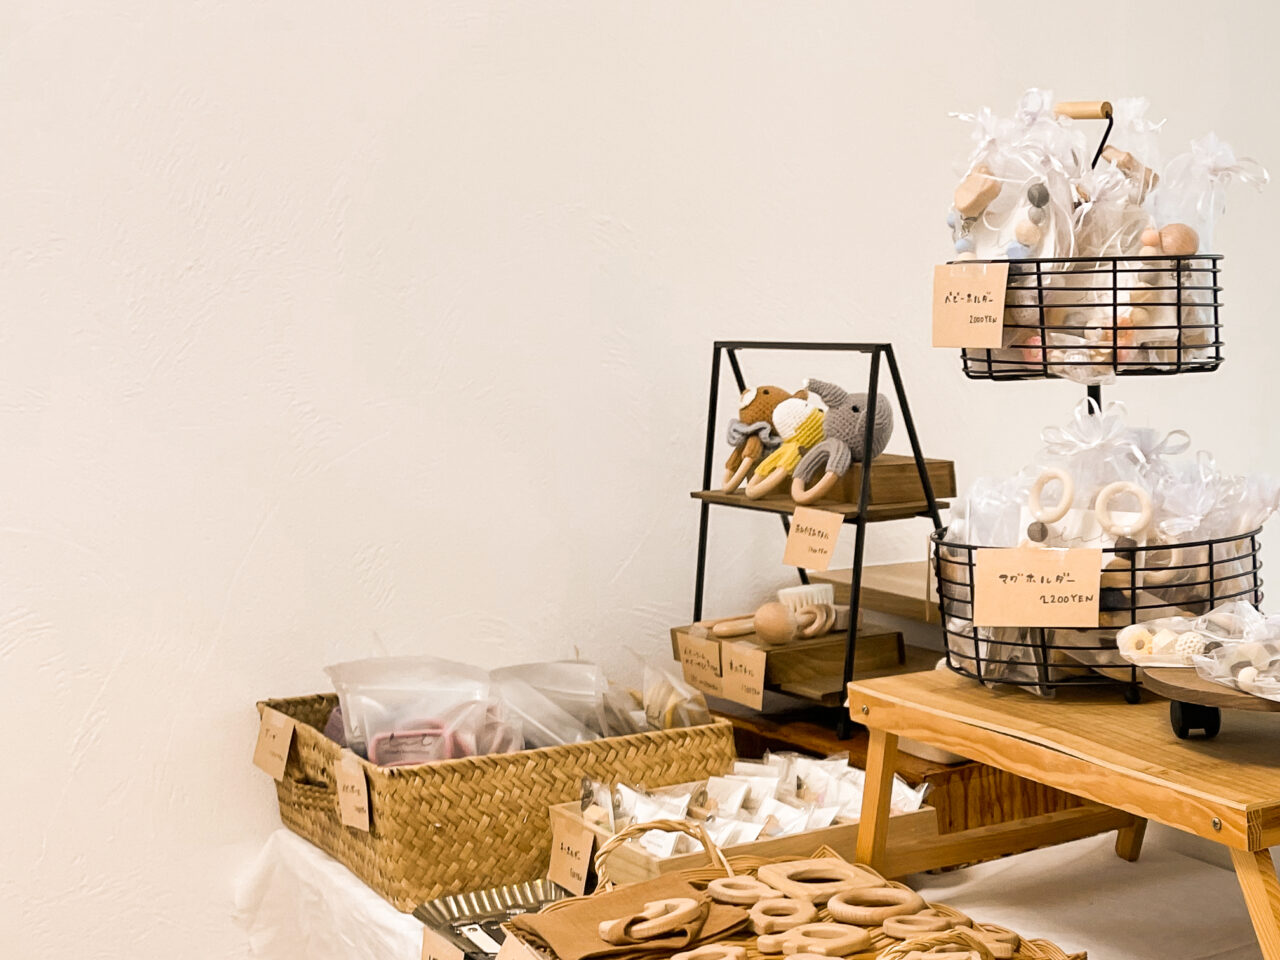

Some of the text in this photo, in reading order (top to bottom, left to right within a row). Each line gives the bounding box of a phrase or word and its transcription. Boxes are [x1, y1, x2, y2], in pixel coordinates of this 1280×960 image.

[998, 572, 1076, 585] マグホルダー
[1039, 594, 1094, 604] 2200YEN
